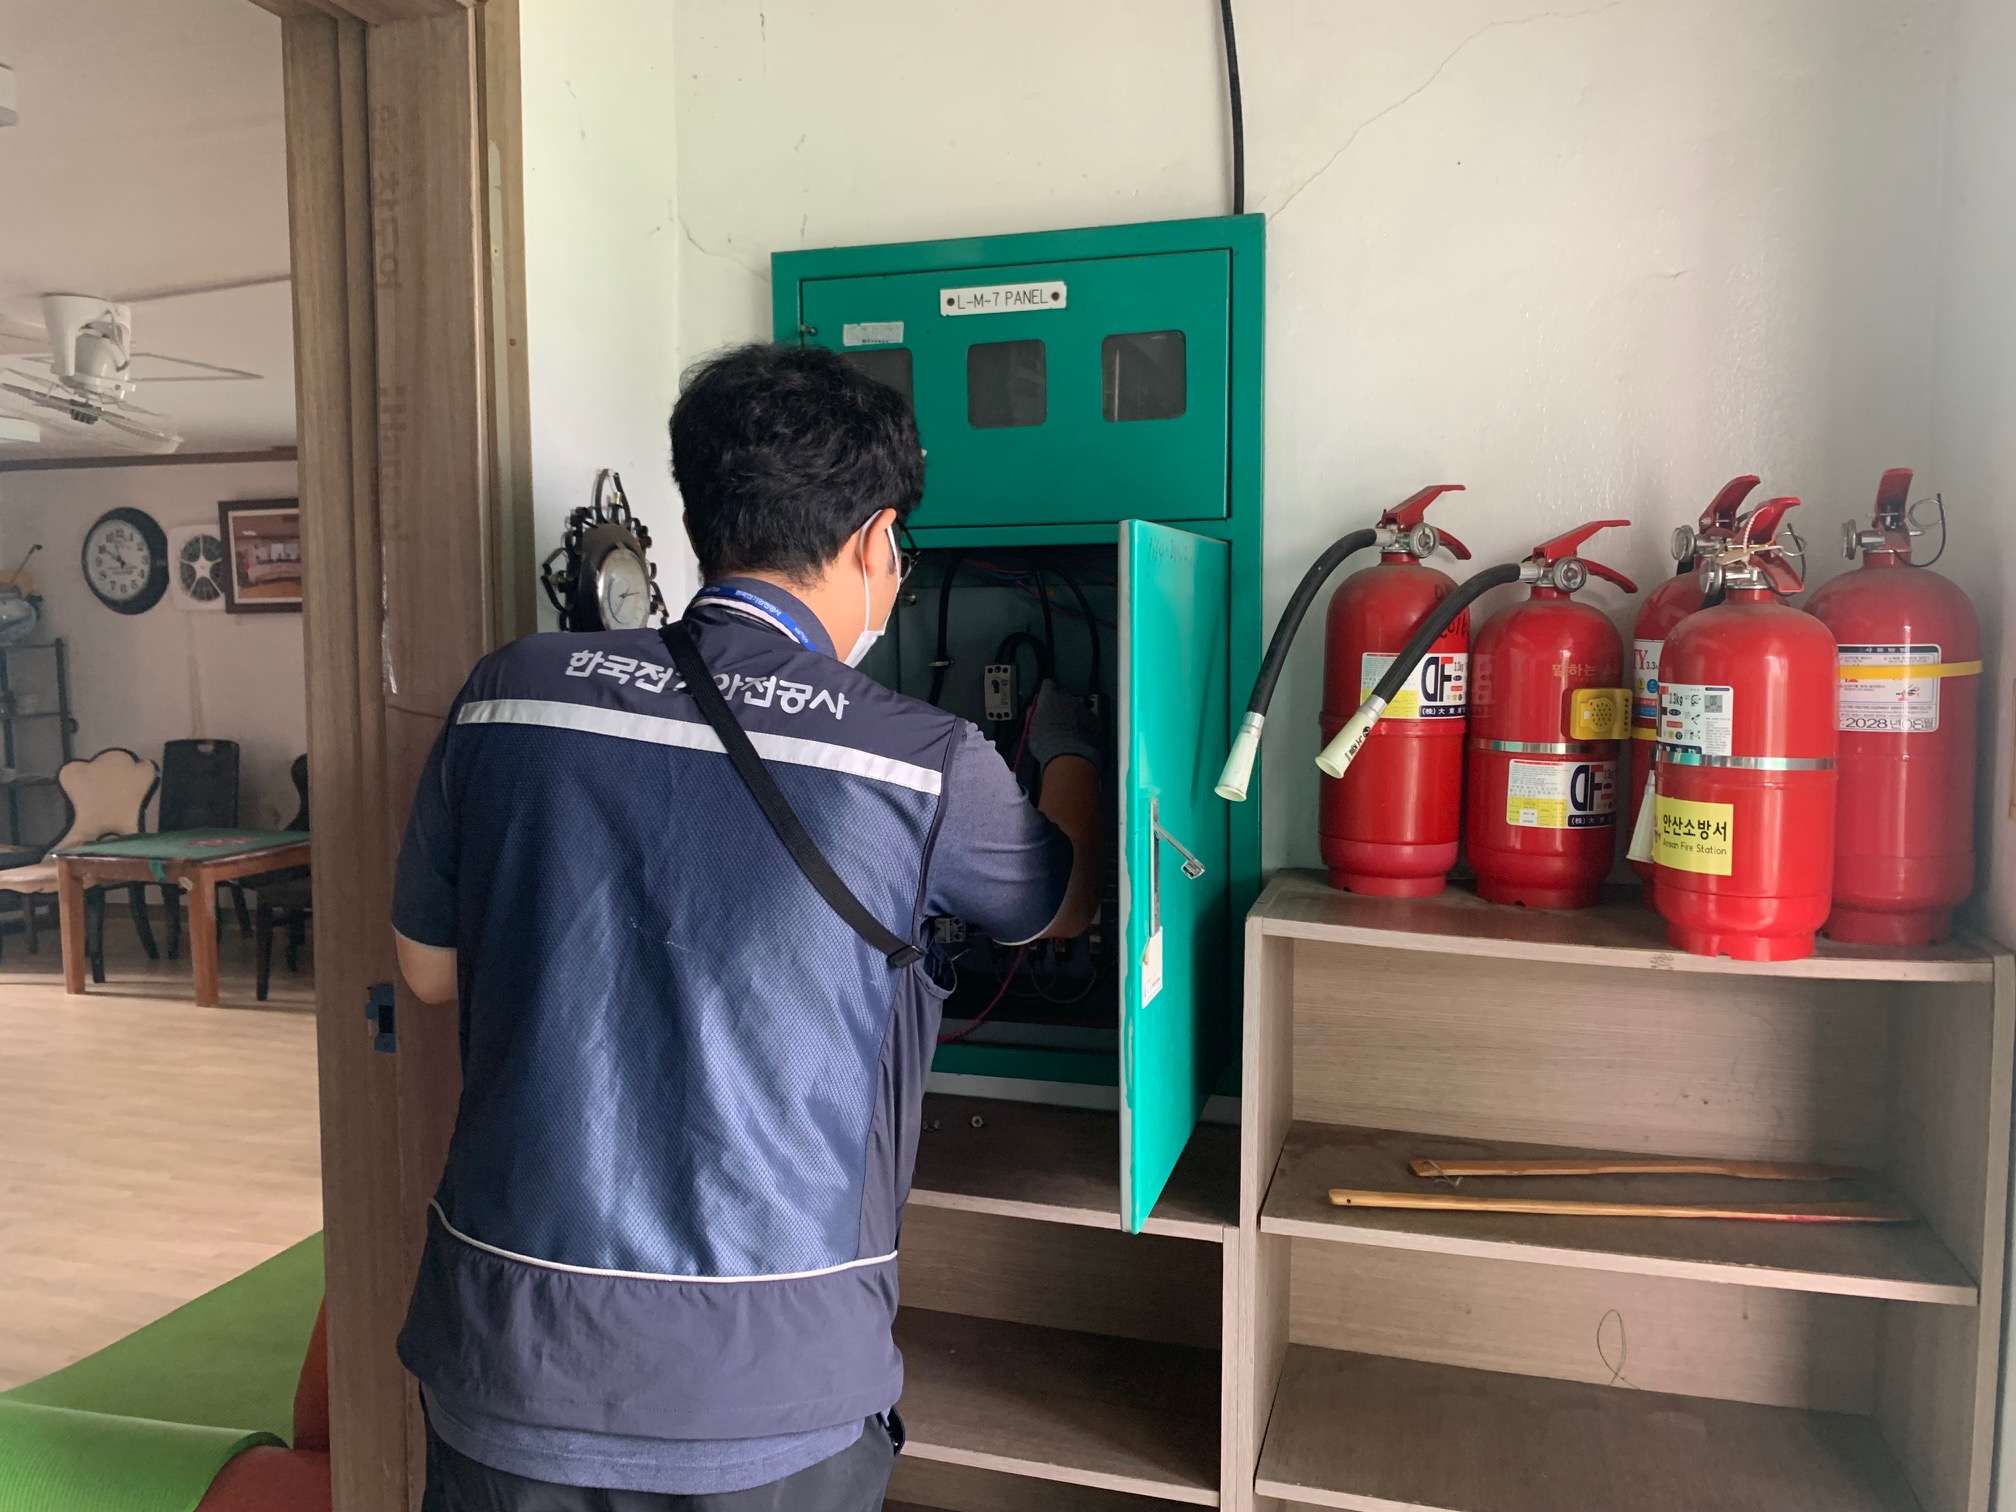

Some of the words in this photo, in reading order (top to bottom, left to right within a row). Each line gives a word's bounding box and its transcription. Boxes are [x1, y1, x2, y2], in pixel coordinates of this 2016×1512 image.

[957, 292, 999, 310] L-M-7
[1005, 289, 1048, 306] PANEL
[565, 649, 849, 720] 한국전안전공사
[1662, 814, 1727, 842] 안산소방서
[1680, 841, 1694, 852] Fire
[1696, 844, 1727, 856] Station
